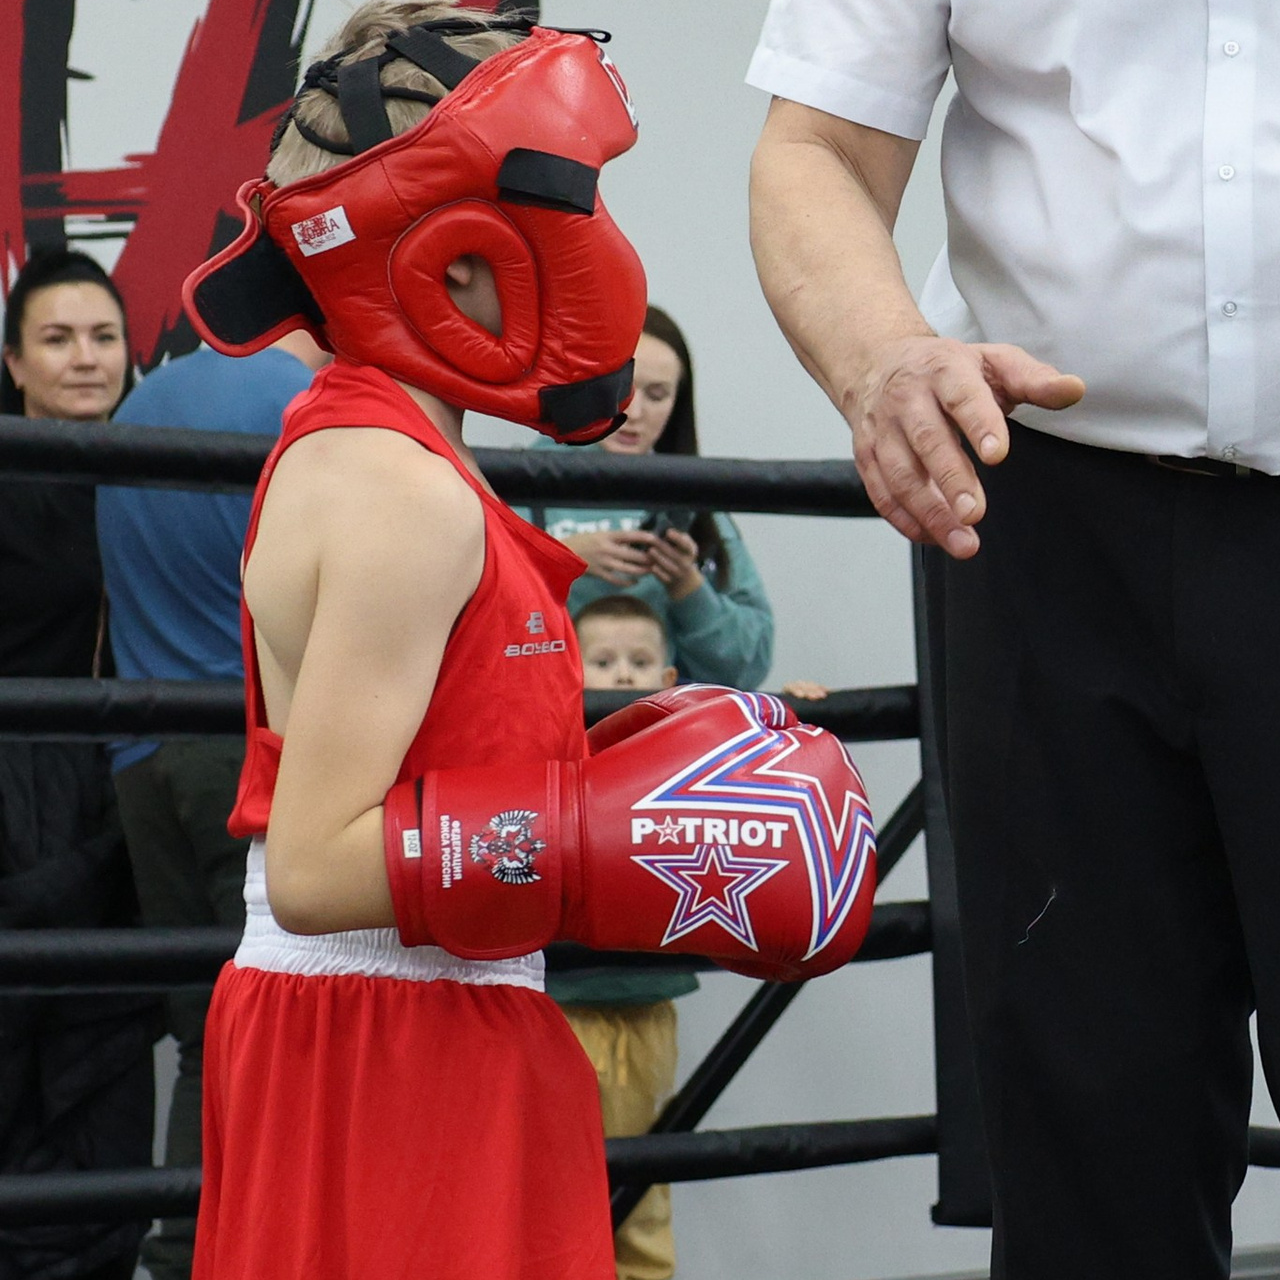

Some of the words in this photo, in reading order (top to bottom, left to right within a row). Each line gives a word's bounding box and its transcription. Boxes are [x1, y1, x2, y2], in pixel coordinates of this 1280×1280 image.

[440, 814, 451, 847] БОКСА
[631, 815, 789, 849] PTRIOT
[441, 847, 452, 889] РОССИИ
[451, 820, 462, 881] ФЕДЕРАЦИЯ
